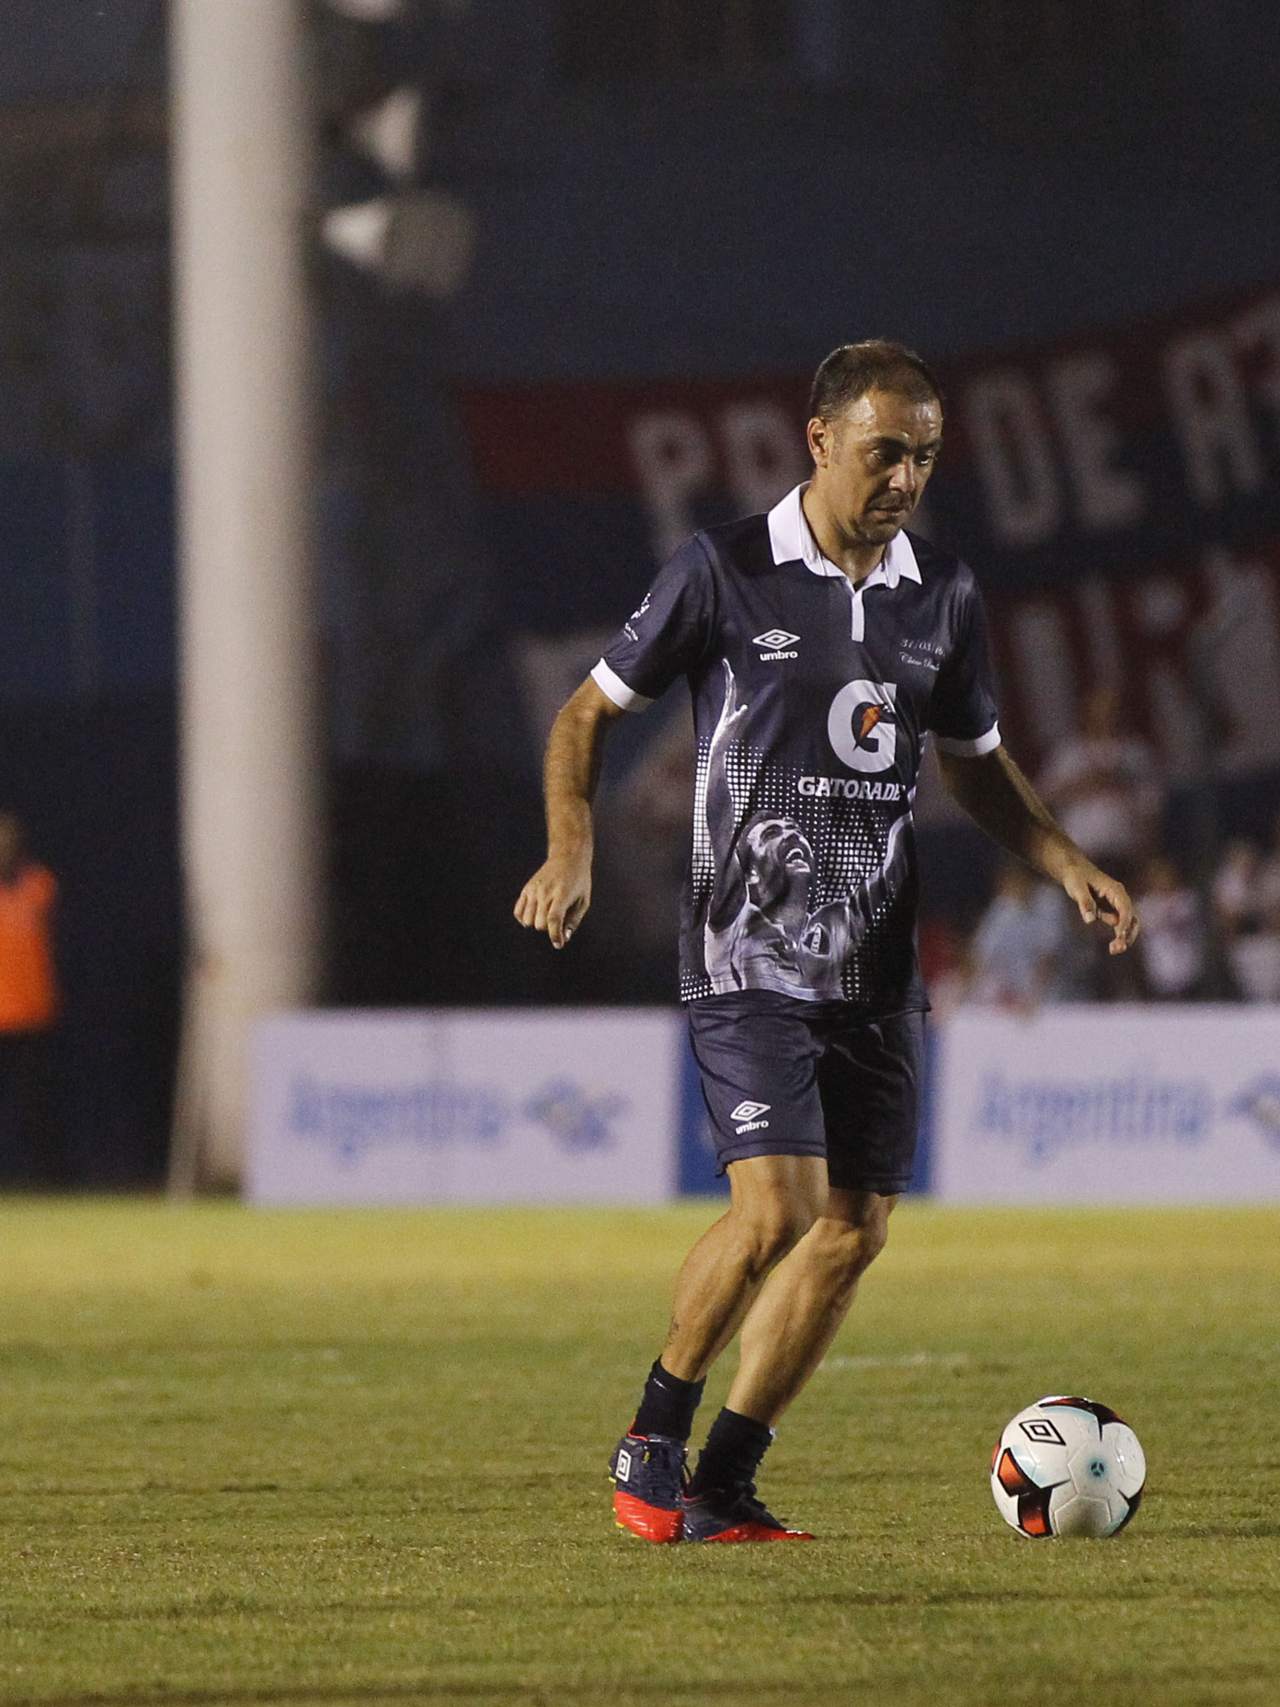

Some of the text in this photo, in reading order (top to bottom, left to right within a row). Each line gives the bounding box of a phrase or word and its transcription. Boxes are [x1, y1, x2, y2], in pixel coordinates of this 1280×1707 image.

[965, 355, 1148, 546] DE
[760, 650, 798, 661] umbro
[735, 1120, 769, 1135] umbro
